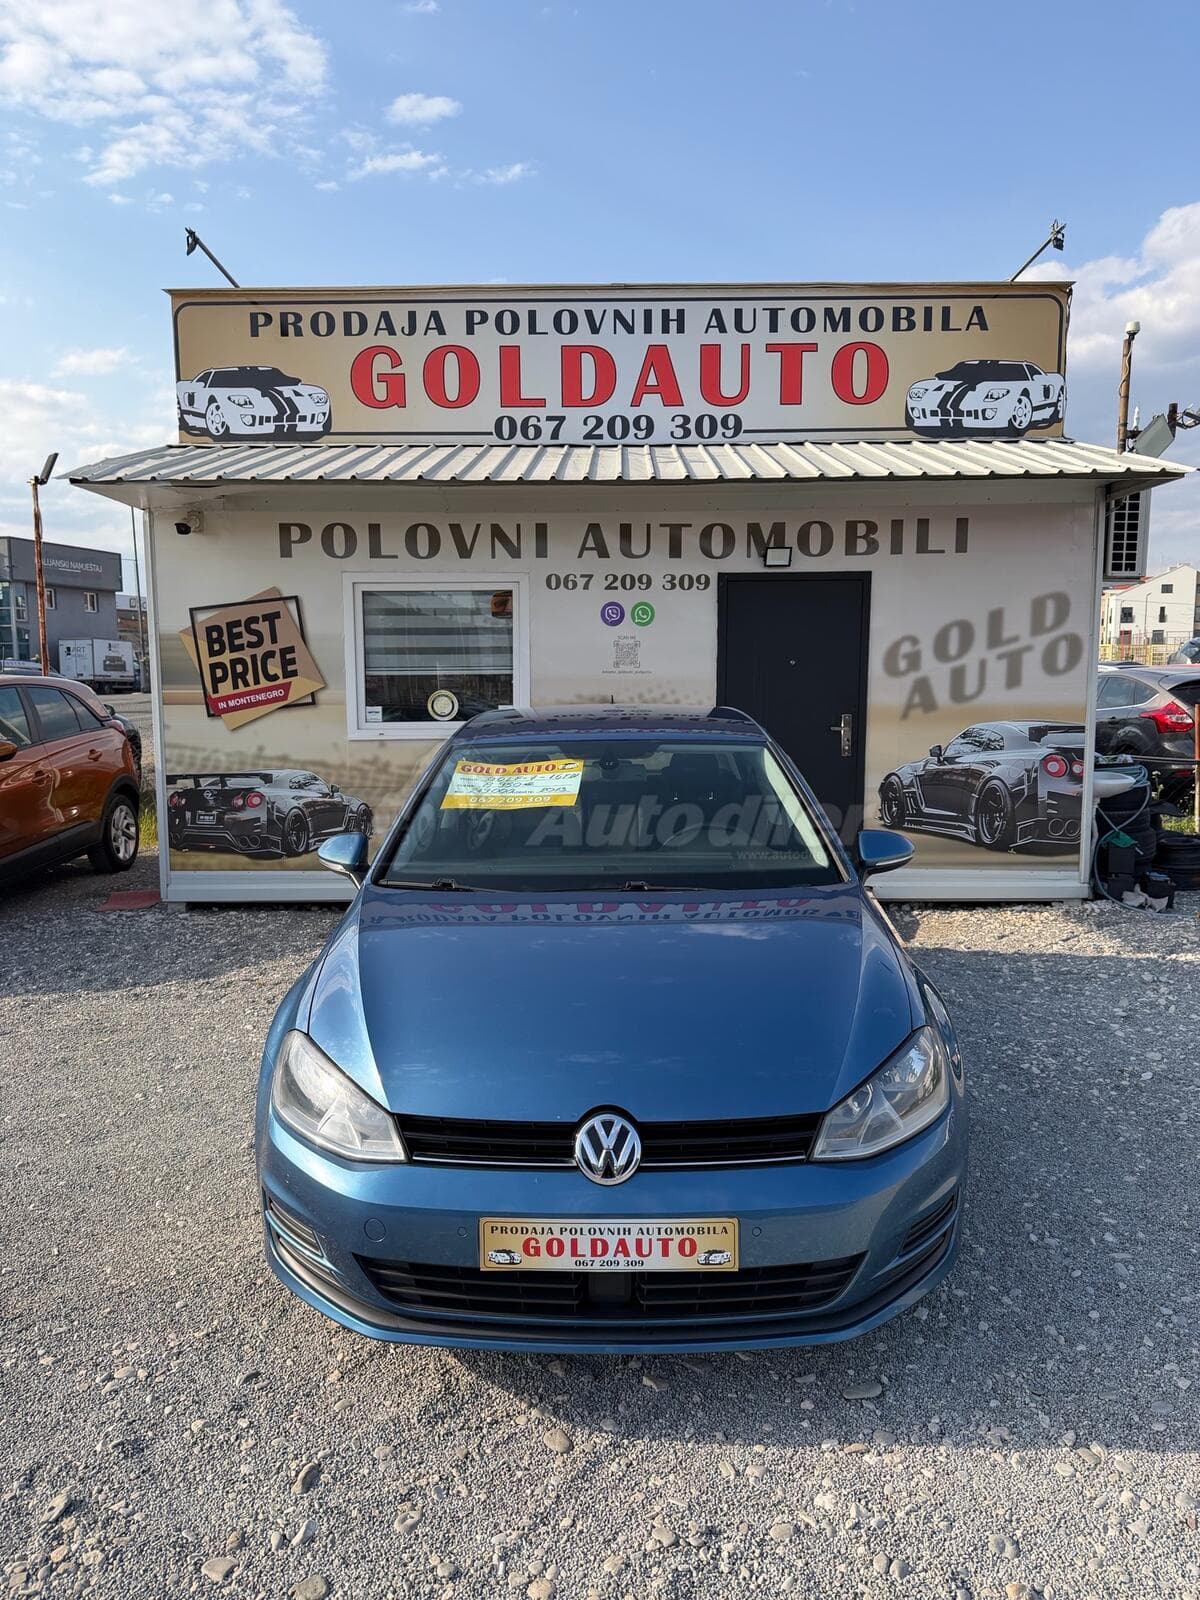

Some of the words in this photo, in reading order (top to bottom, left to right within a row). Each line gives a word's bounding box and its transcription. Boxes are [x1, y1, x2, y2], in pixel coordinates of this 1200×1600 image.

[250, 310, 447, 337] PRODAJA
[465, 307, 685, 336] POLOVNIH
[704, 305, 989, 334] AUTOMOBILA
[350, 341, 889, 409] GOLDAUTO
[494, 415, 566, 441] 067
[583, 414, 655, 440] 209
[670, 413, 743, 439] 309
[279, 522, 549, 559] POLOVNI
[577, 517, 969, 560] AUTOMOBILI
[545, 573, 593, 591] 067
[604, 573, 652, 591] 209
[662, 573, 711, 591] 309
[205, 611, 281, 658] BEST
[882, 591, 1071, 679] GOLD
[209, 645, 298, 695] PRICE
[901, 632, 1084, 720] AUTO
[218, 702, 227, 710] IN
[228, 689, 285, 707] MONTENEGRO
[460, 764, 507, 775] GOLD
[513, 763, 557, 774] AUTO
[490, 1225, 555, 1236] PRODAJA
[560, 1226, 632, 1236] POLOVNIH
[637, 1225, 729, 1236] AUTOMOBILA
[522, 1237, 698, 1258] GOLDAUTO
[574, 1259, 595, 1267] 067
[599, 1259, 620, 1267] 209
[623, 1259, 645, 1267] 309
